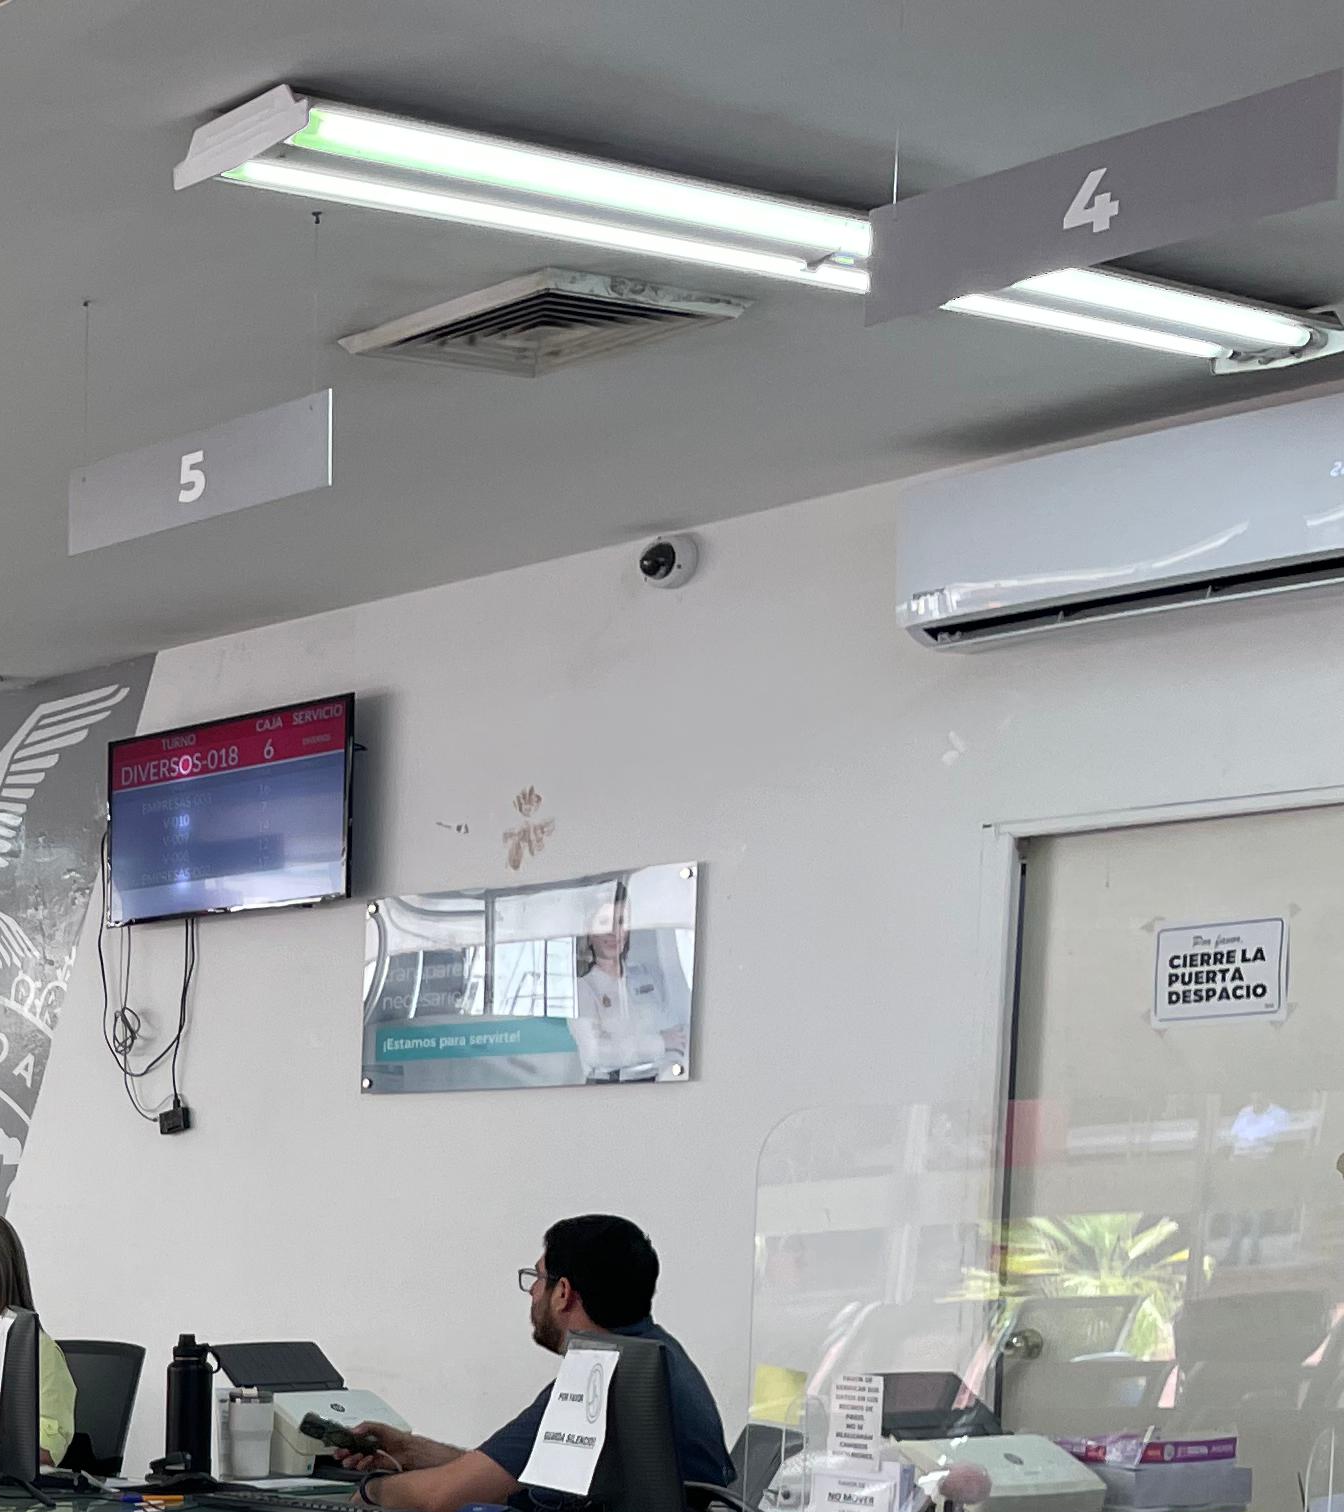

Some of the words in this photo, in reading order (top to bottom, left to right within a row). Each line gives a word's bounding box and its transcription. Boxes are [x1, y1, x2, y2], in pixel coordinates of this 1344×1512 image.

[1062, 168, 1119, 233] 4
[177, 450, 207, 503] 5
[162, 734, 196, 750] TURNO
[255, 718, 283, 732] CAJA
[292, 703, 344, 726] SERVICIO
[121, 745, 239, 786] DIVERSOS-018
[263, 739, 275, 760] 6
[1168, 949, 1237, 970] CIERRE
[1241, 946, 1266, 964] LA
[1168, 966, 1244, 988] PUERTA
[1167, 983, 1268, 1006] DESPACIO
[383, 1037, 436, 1053] ¡Estamos
[439, 1035, 467, 1050] para
[469, 1030, 521, 1046] servirte!
[827, 1492, 842, 1503] NO
[843, 1493, 875, 1506] MOVER
